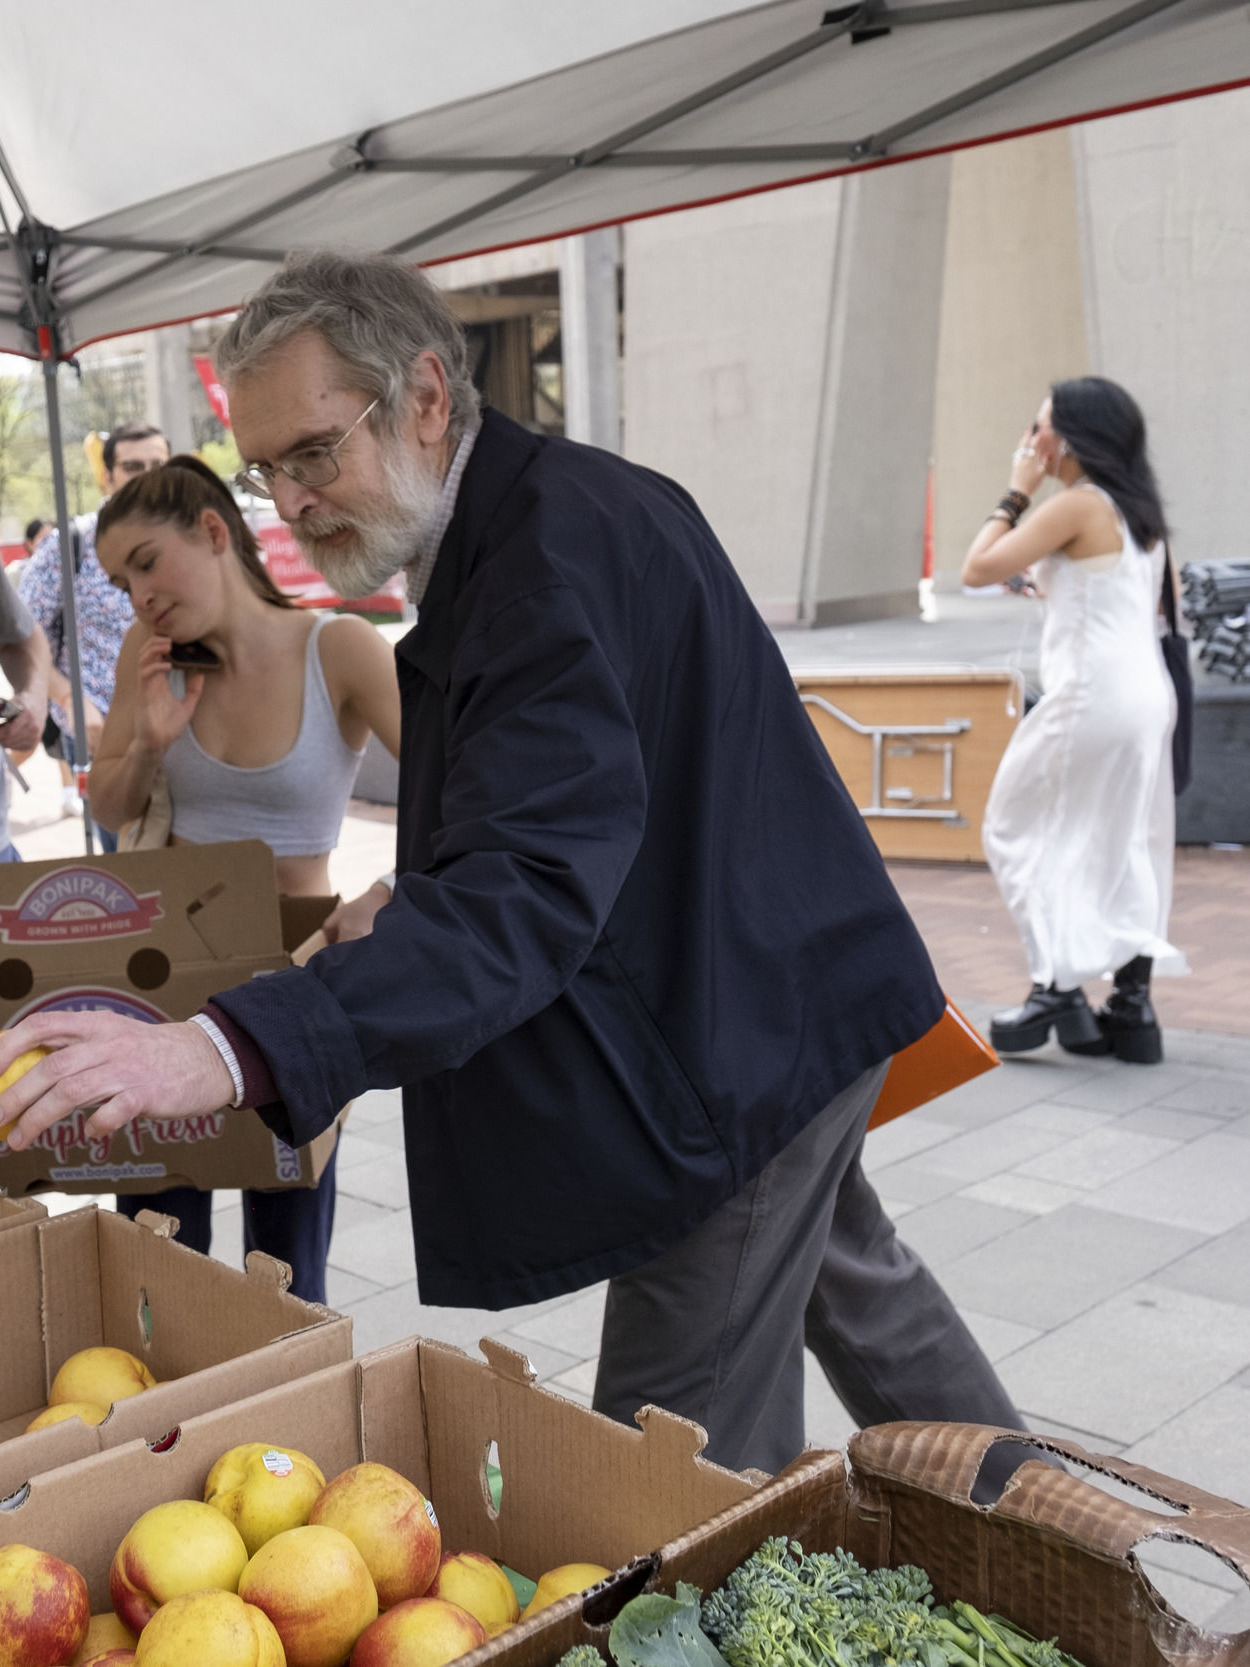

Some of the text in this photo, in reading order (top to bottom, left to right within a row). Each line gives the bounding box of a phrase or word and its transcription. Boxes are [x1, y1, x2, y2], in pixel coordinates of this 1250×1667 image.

[28, 876, 125, 917] BONIPAK
[27, 919, 132, 937] GROWN WITH PRIDE
[52, 1165, 165, 1181] www.bonipak.com
